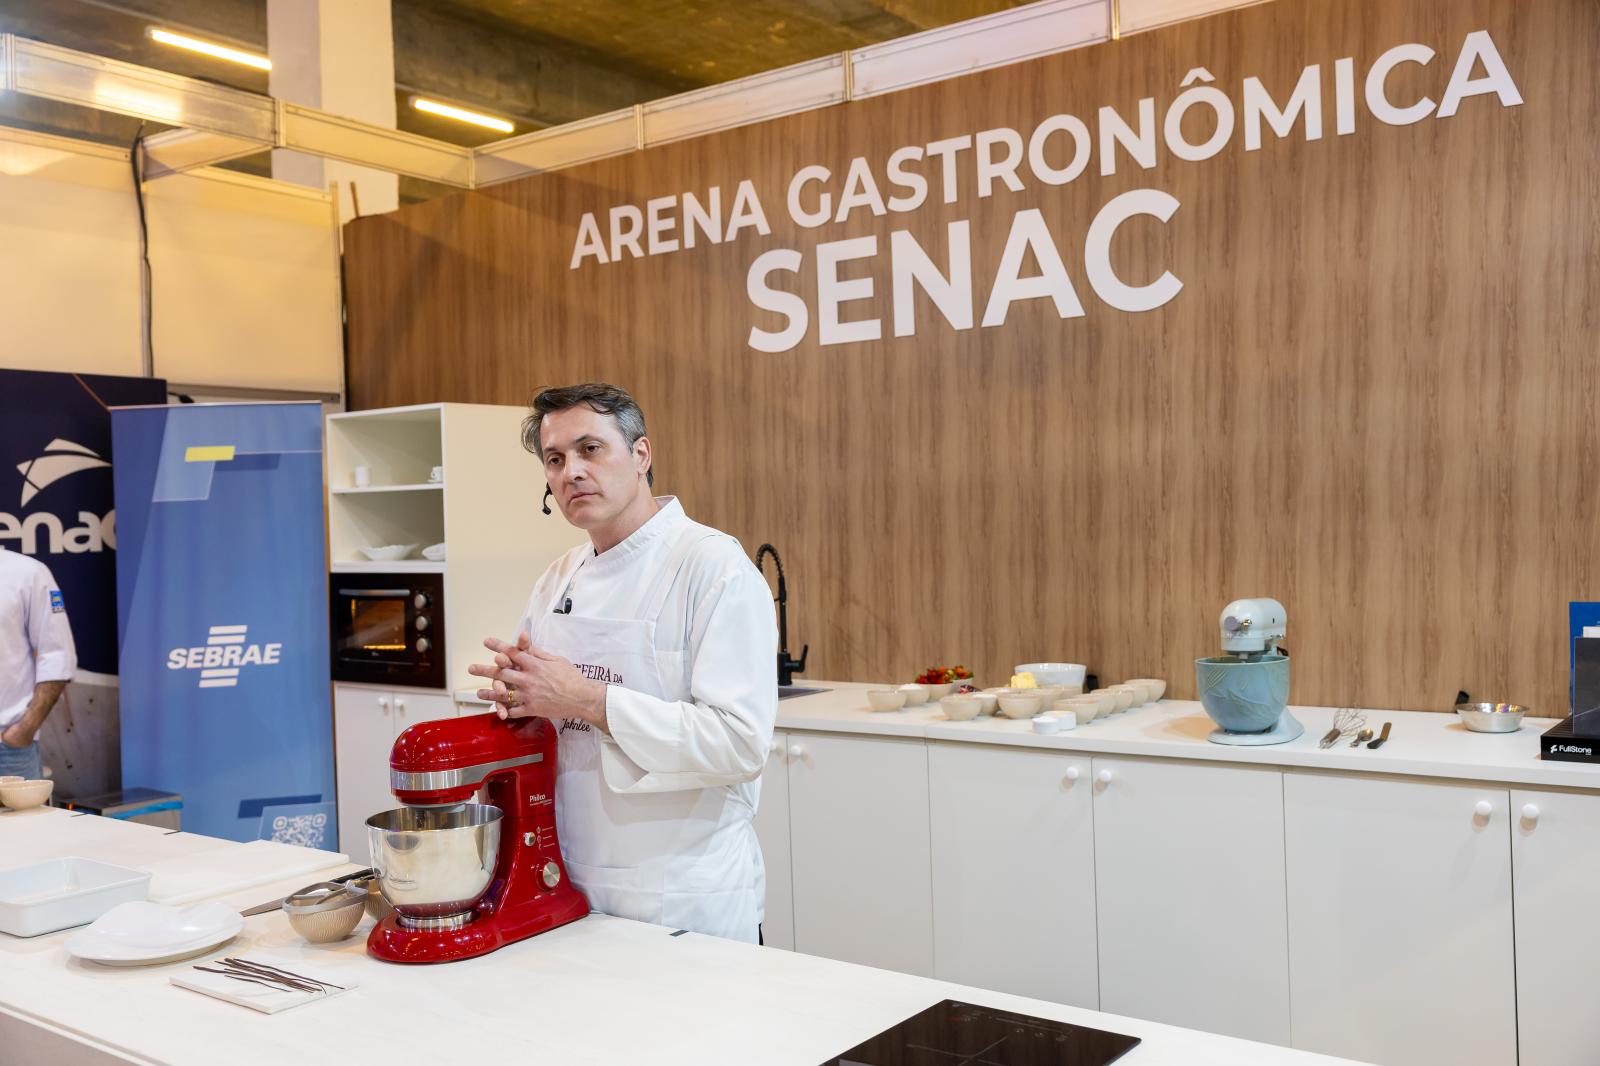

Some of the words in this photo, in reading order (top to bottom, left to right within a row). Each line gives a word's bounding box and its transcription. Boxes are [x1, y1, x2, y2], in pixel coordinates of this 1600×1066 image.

[571, 180, 772, 269] ARENA
[786, 30, 1524, 232] GASTRONÔMICA
[746, 188, 1185, 353] SENAC
[167, 643, 282, 669] SEBRAE
[613, 673, 623, 684] DA
[1558, 744, 1592, 754] FullStone
[529, 793, 546, 803] Philco
